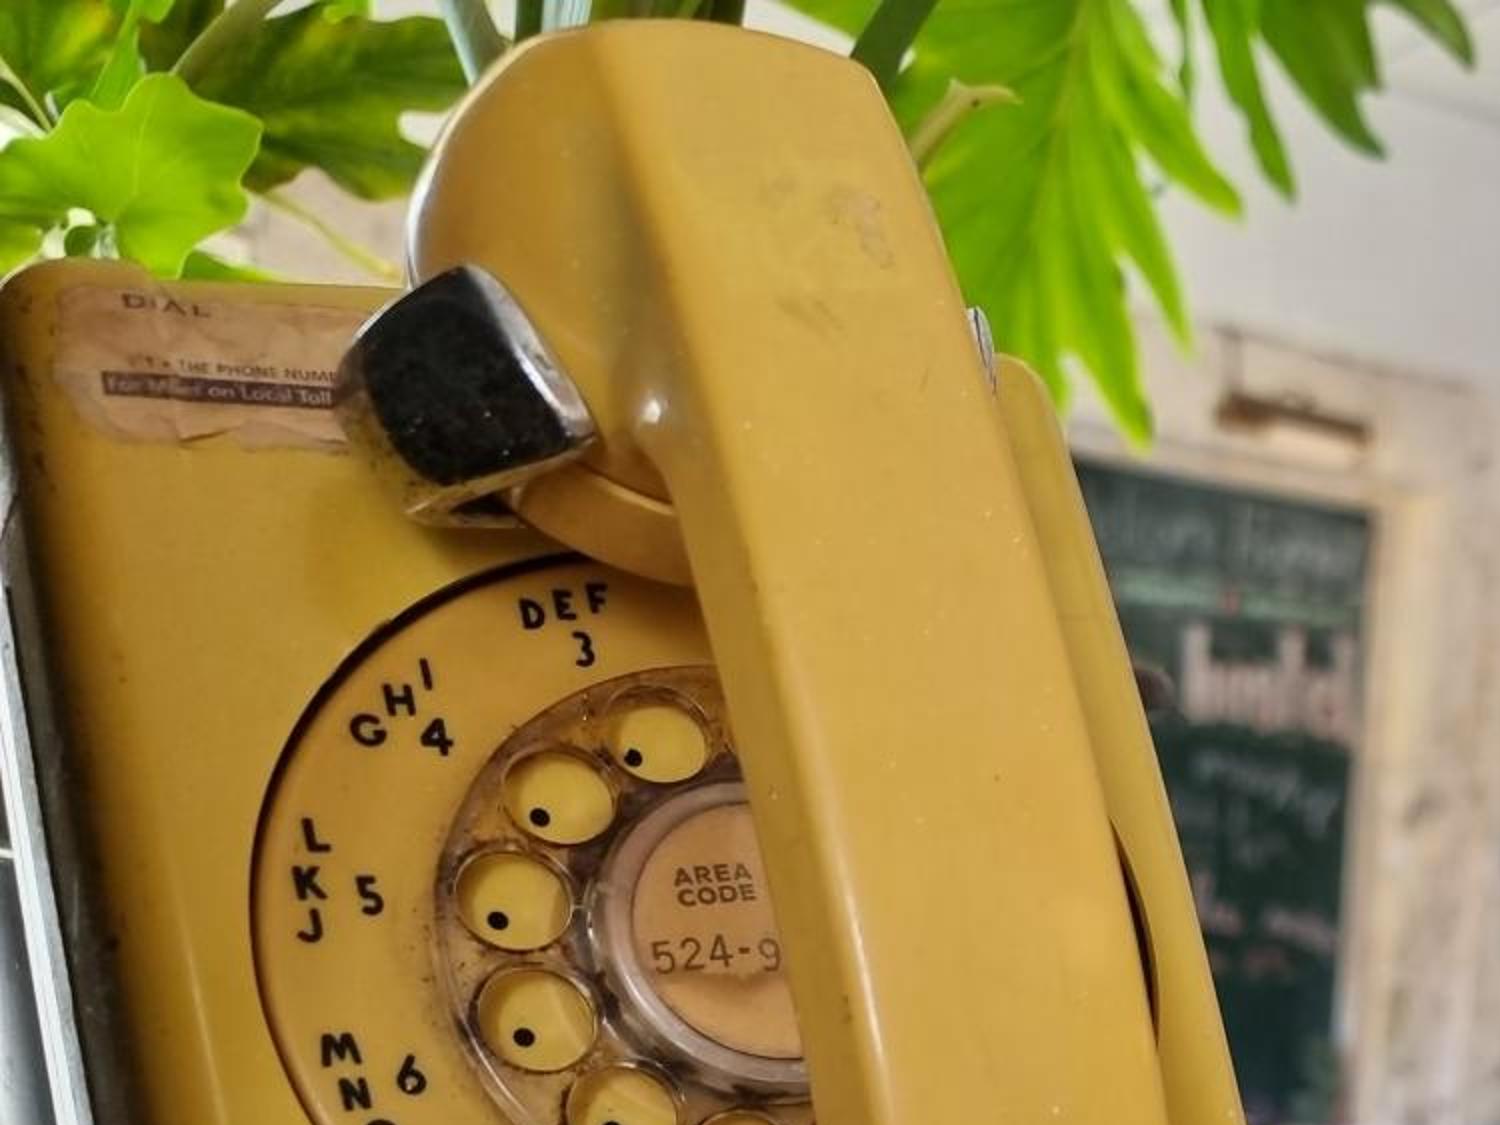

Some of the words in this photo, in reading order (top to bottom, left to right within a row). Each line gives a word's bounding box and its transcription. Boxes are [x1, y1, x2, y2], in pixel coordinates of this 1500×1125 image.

[121, 292, 212, 318] DIAL
[216, 362, 280, 378] PHONE
[207, 385, 236, 399] on
[241, 384, 293, 402] Local
[299, 390, 332, 406] Toll
[572, 631, 596, 668] 3
[420, 717, 454, 757] 4
[674, 863, 753, 887] AREA
[354, 875, 385, 916] 5
[676, 883, 757, 907] CODE
[651, 933, 782, 975] 524-9
[396, 1053, 427, 1096] 6
